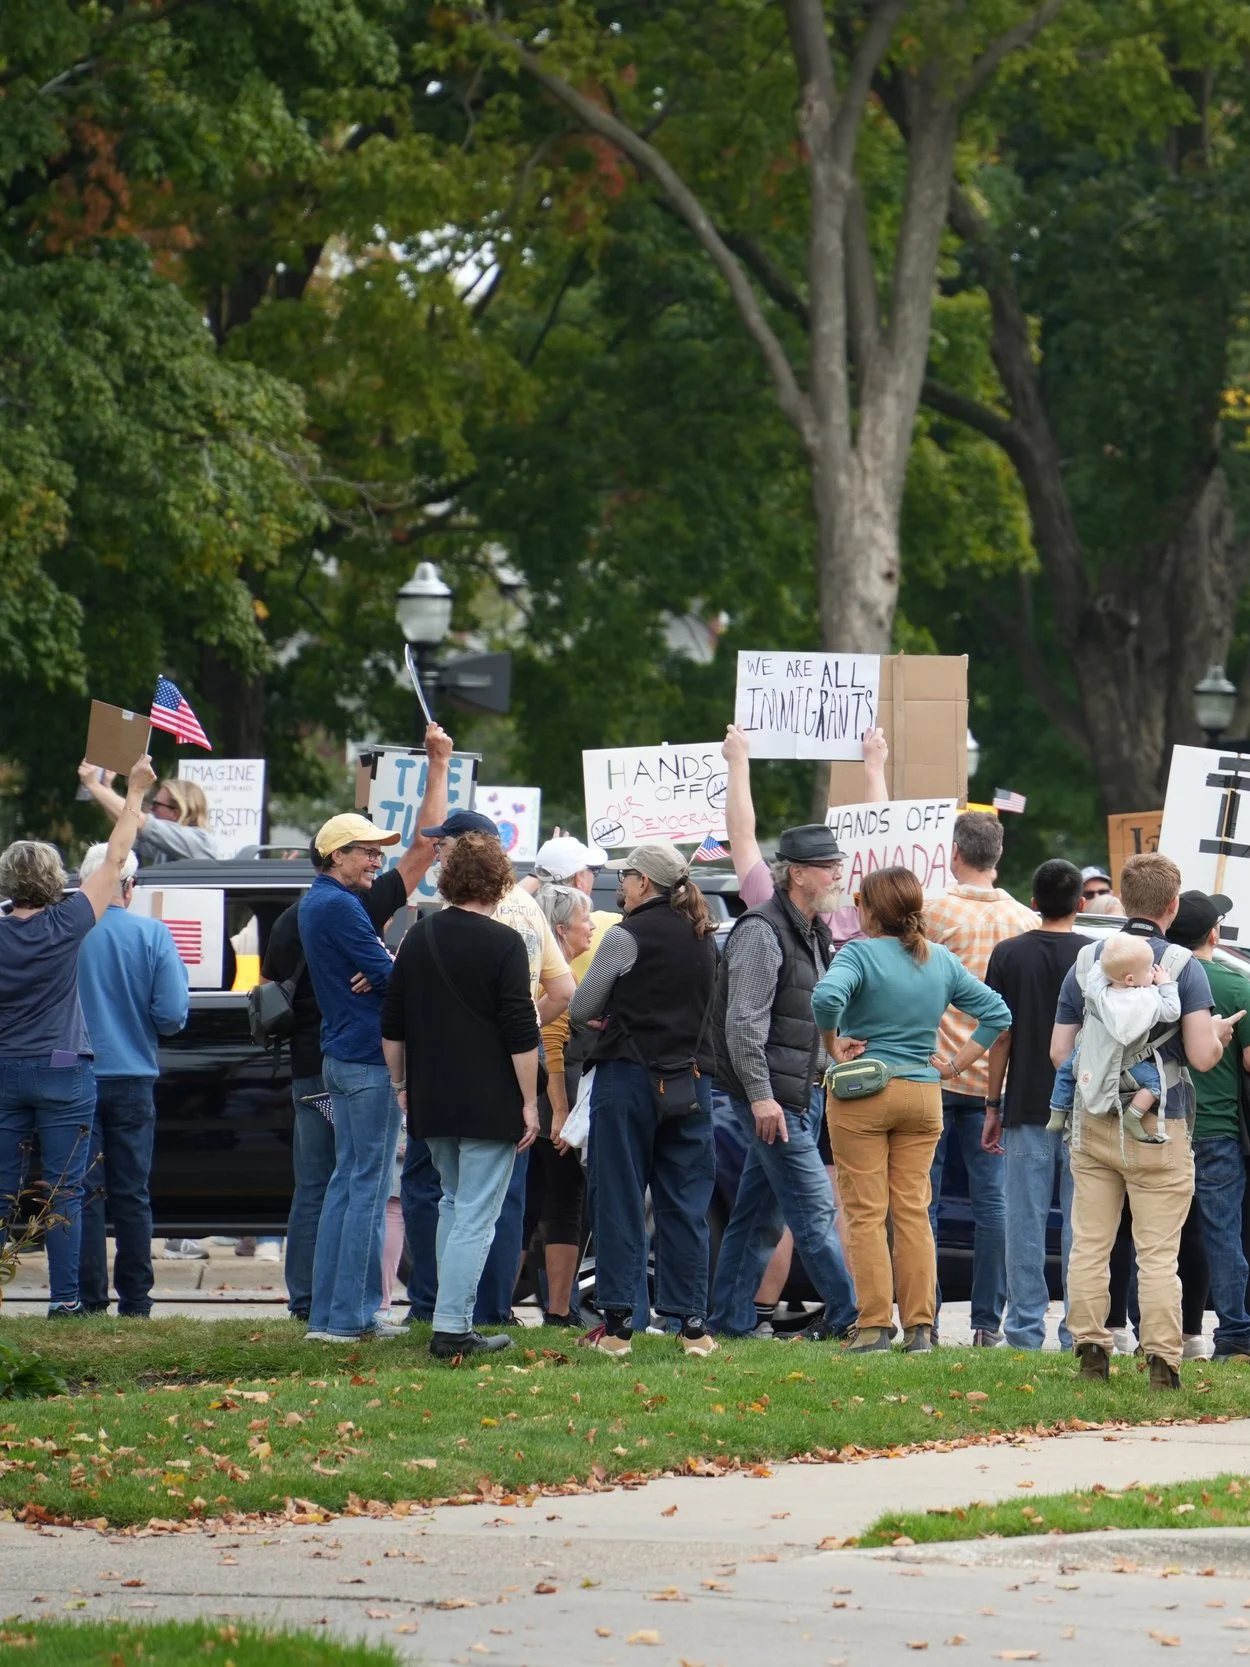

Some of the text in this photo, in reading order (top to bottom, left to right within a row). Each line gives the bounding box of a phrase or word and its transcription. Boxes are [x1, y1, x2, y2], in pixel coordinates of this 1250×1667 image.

[747, 656, 866, 689] WE ARE ALL
[743, 686, 874, 742] IMMIGRANTS
[184, 764, 256, 781] IMAGINE
[607, 754, 714, 790] HANDS
[655, 783, 704, 801] OFF
[208, 808, 261, 828] ERSITY
[606, 796, 644, 823] OUR
[828, 804, 952, 841] HANDS OFF
